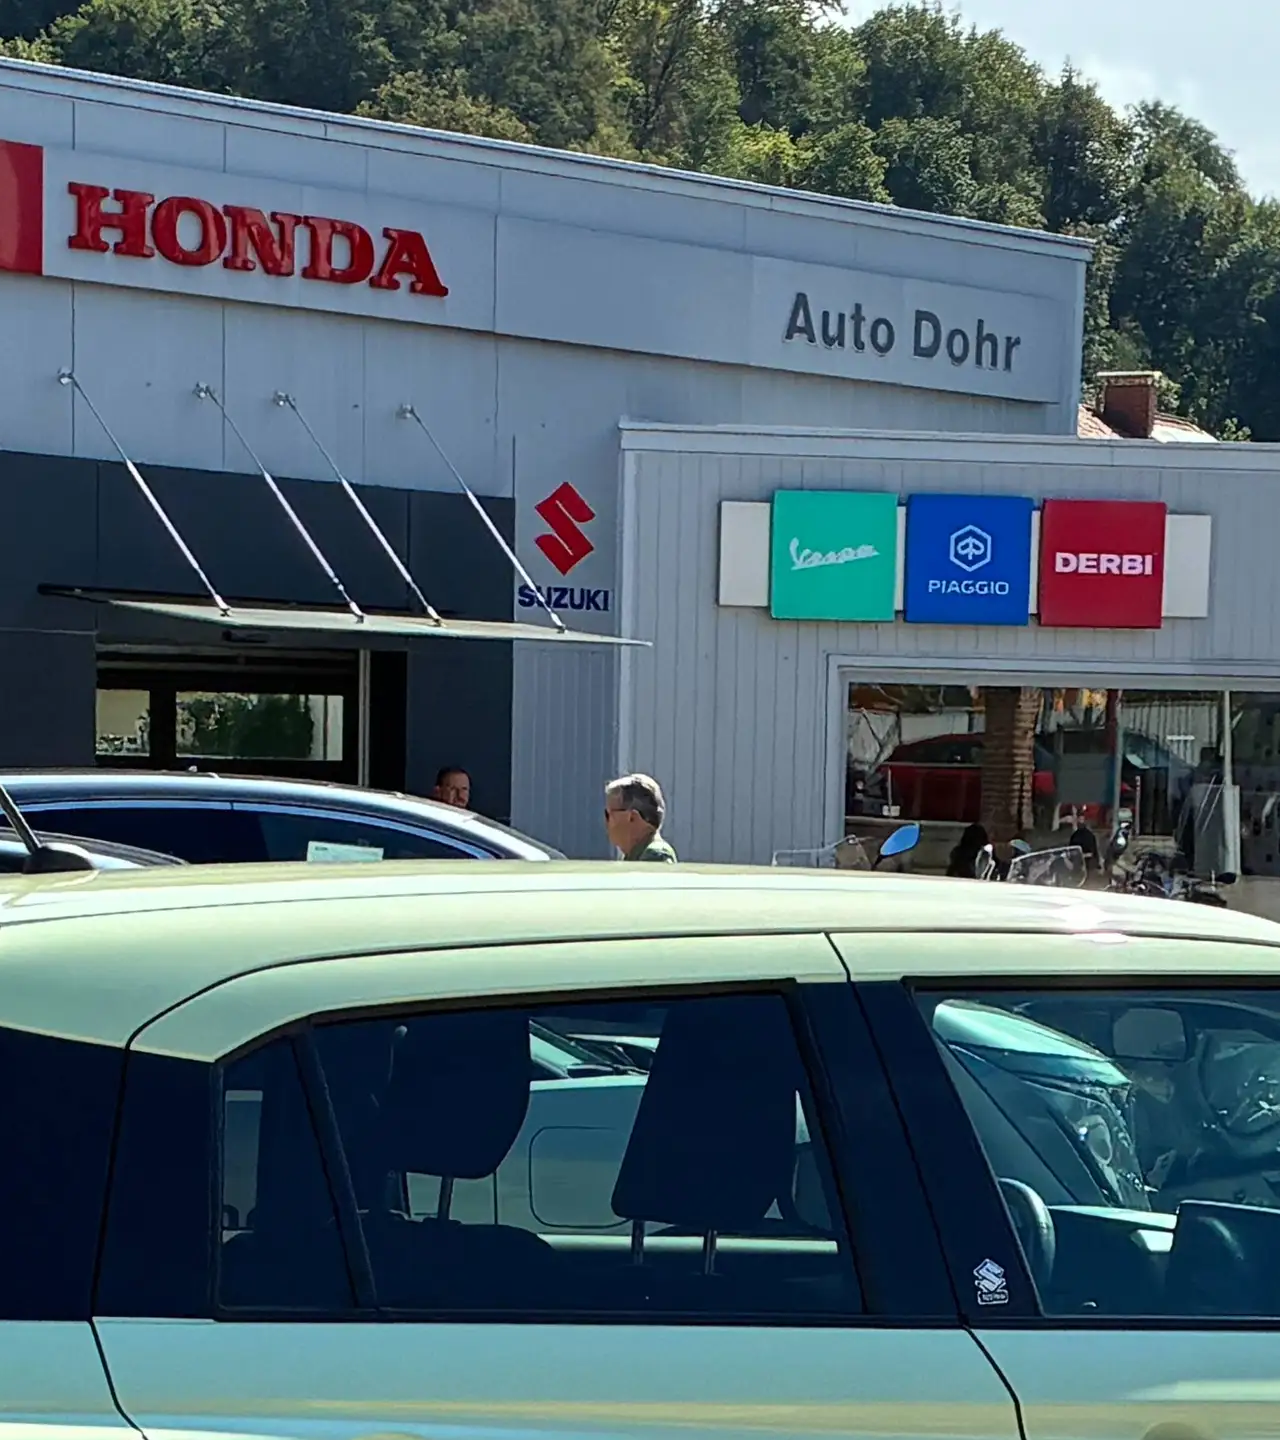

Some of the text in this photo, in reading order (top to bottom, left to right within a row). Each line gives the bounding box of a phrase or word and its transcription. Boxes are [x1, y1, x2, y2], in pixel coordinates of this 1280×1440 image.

[67, 181, 449, 297] HONDA
[784, 292, 1021, 372] Auto Dohr
[789, 537, 881, 571] Vespa
[1055, 551, 1153, 576] DERBI
[518, 584, 610, 612] SUZUKI
[928, 579, 1009, 596] PIAGGIO
